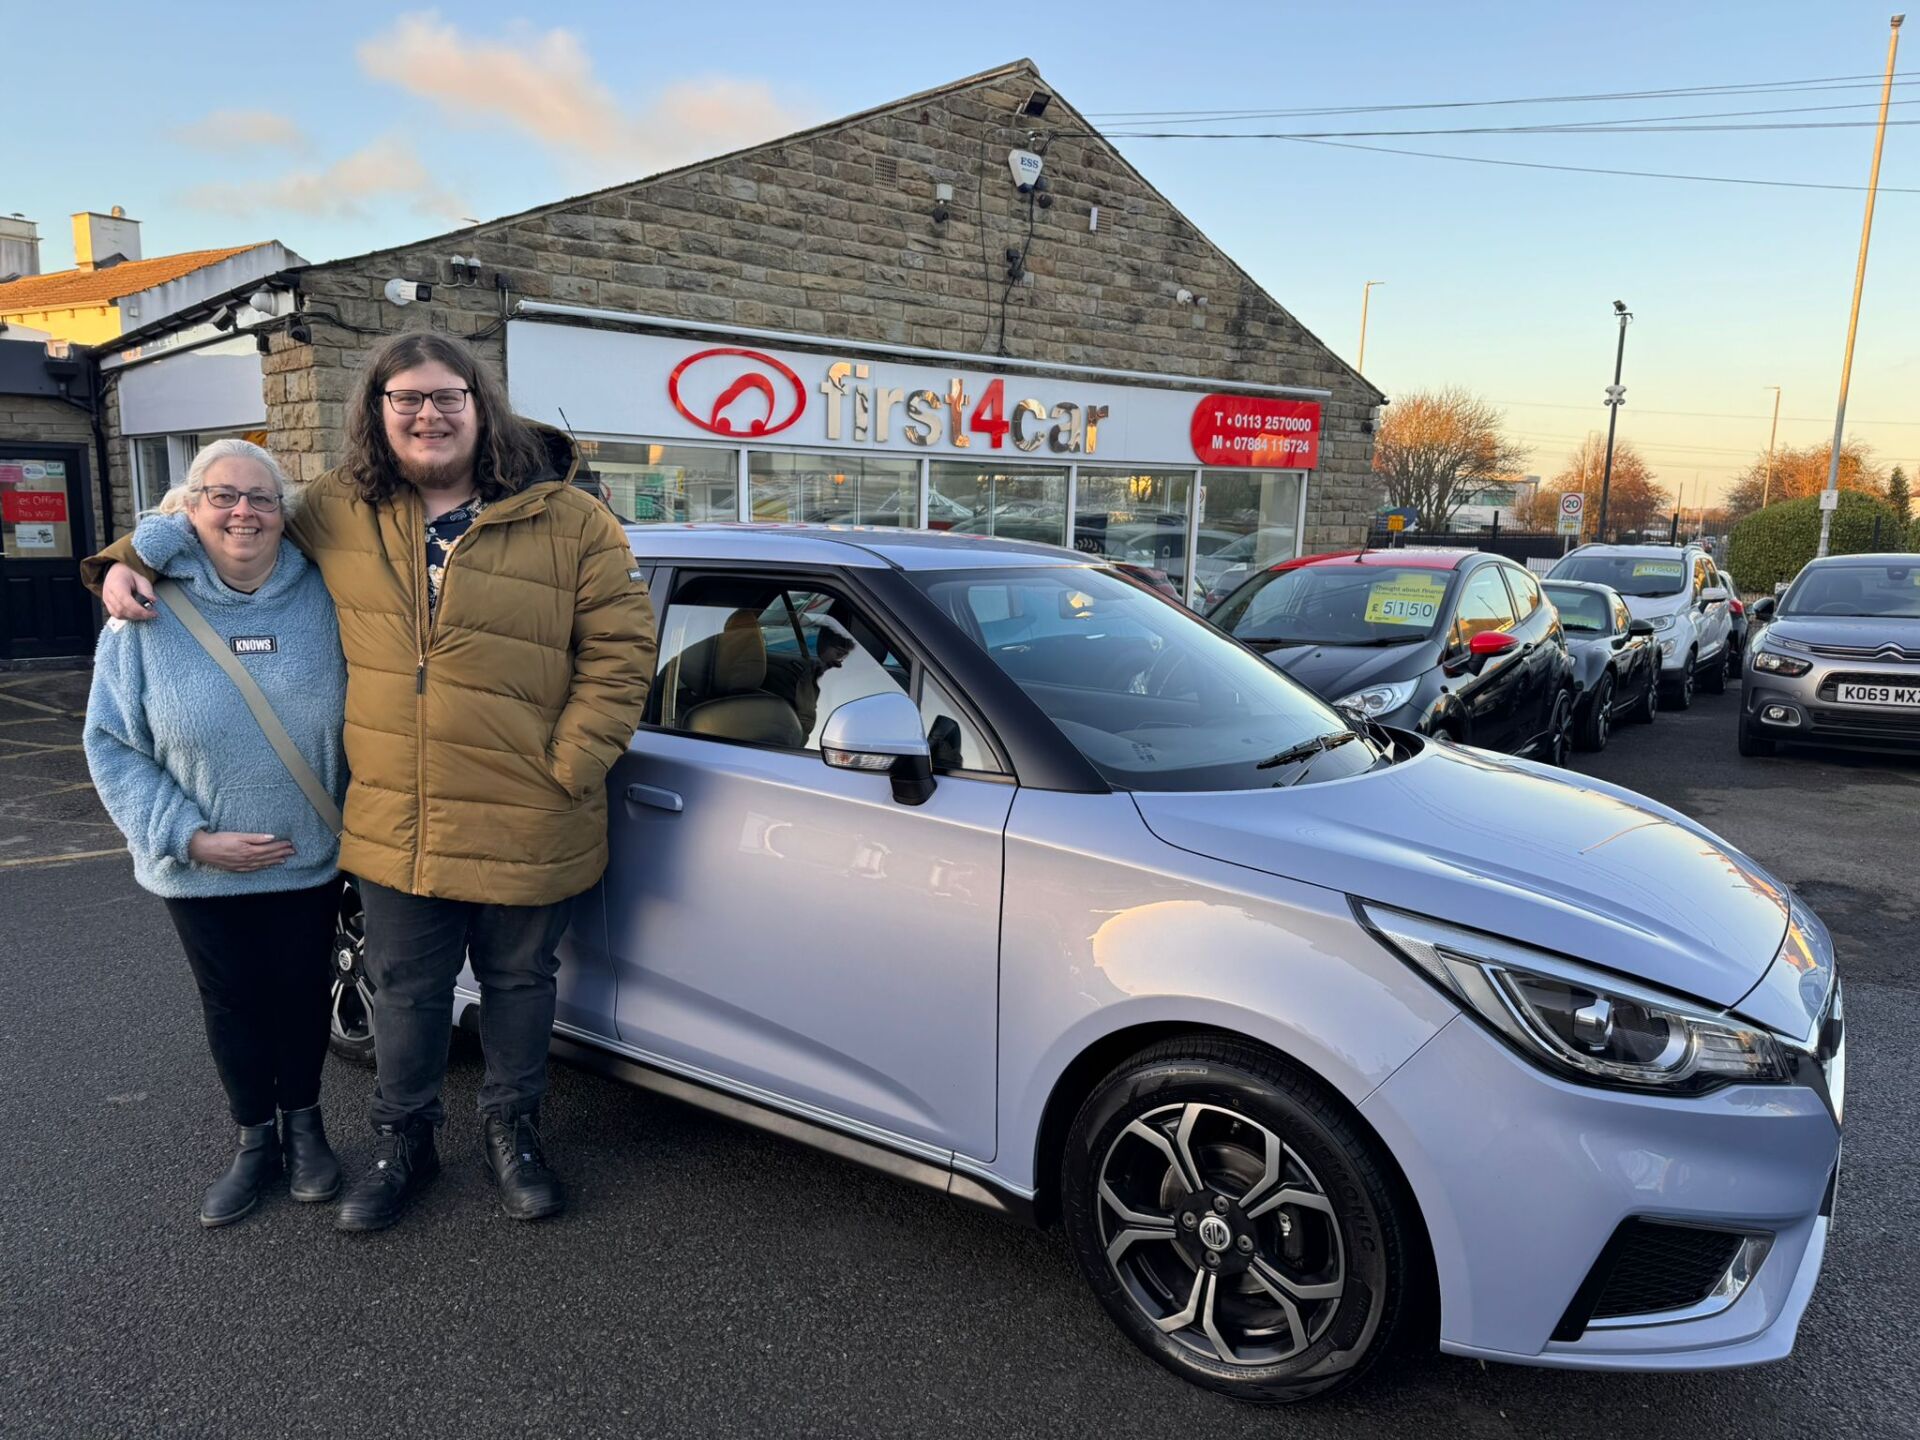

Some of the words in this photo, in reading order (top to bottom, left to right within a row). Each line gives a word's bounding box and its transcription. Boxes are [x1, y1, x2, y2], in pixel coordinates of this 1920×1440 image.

[1020, 156, 1039, 169] ESS
[820, 361, 1109, 454] first4car
[1215, 412, 1224, 426] T
[1234, 414, 1262, 429] 0113
[1265, 416, 1311, 432] 2570000
[1212, 435, 1223, 449] M
[1272, 440, 1309, 453] 115724
[1565, 499, 1579, 509] 20
[235, 639, 271, 652] KNOWS
[1894, 689, 1920, 704] MX
